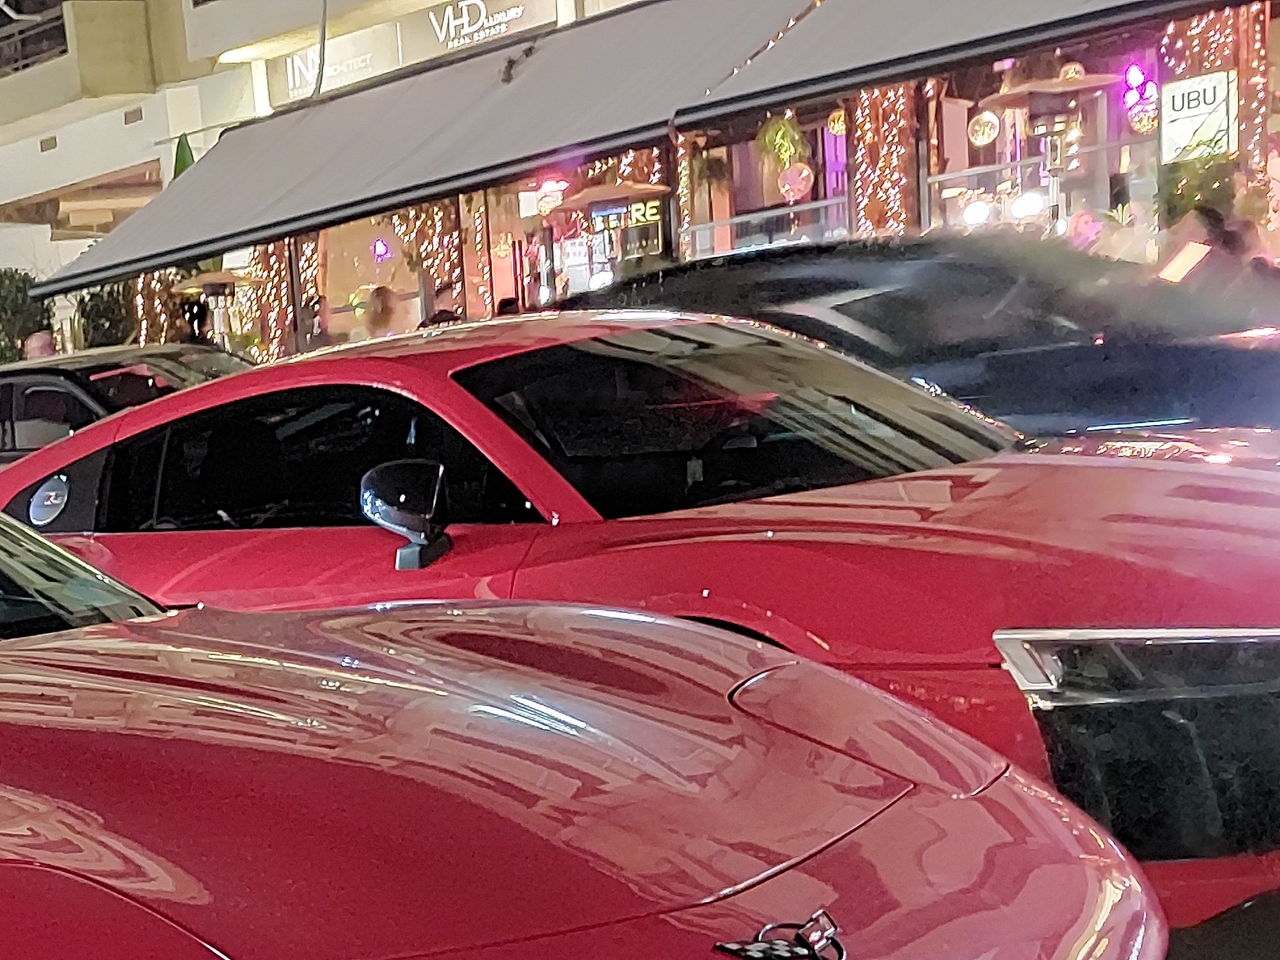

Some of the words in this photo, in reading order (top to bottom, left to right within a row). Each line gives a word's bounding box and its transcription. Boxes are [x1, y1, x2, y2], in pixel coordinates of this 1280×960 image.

[428, 0, 487, 43] VHD
[484, 4, 525, 28] LUXURY
[1171, 85, 1217, 112] UBU
